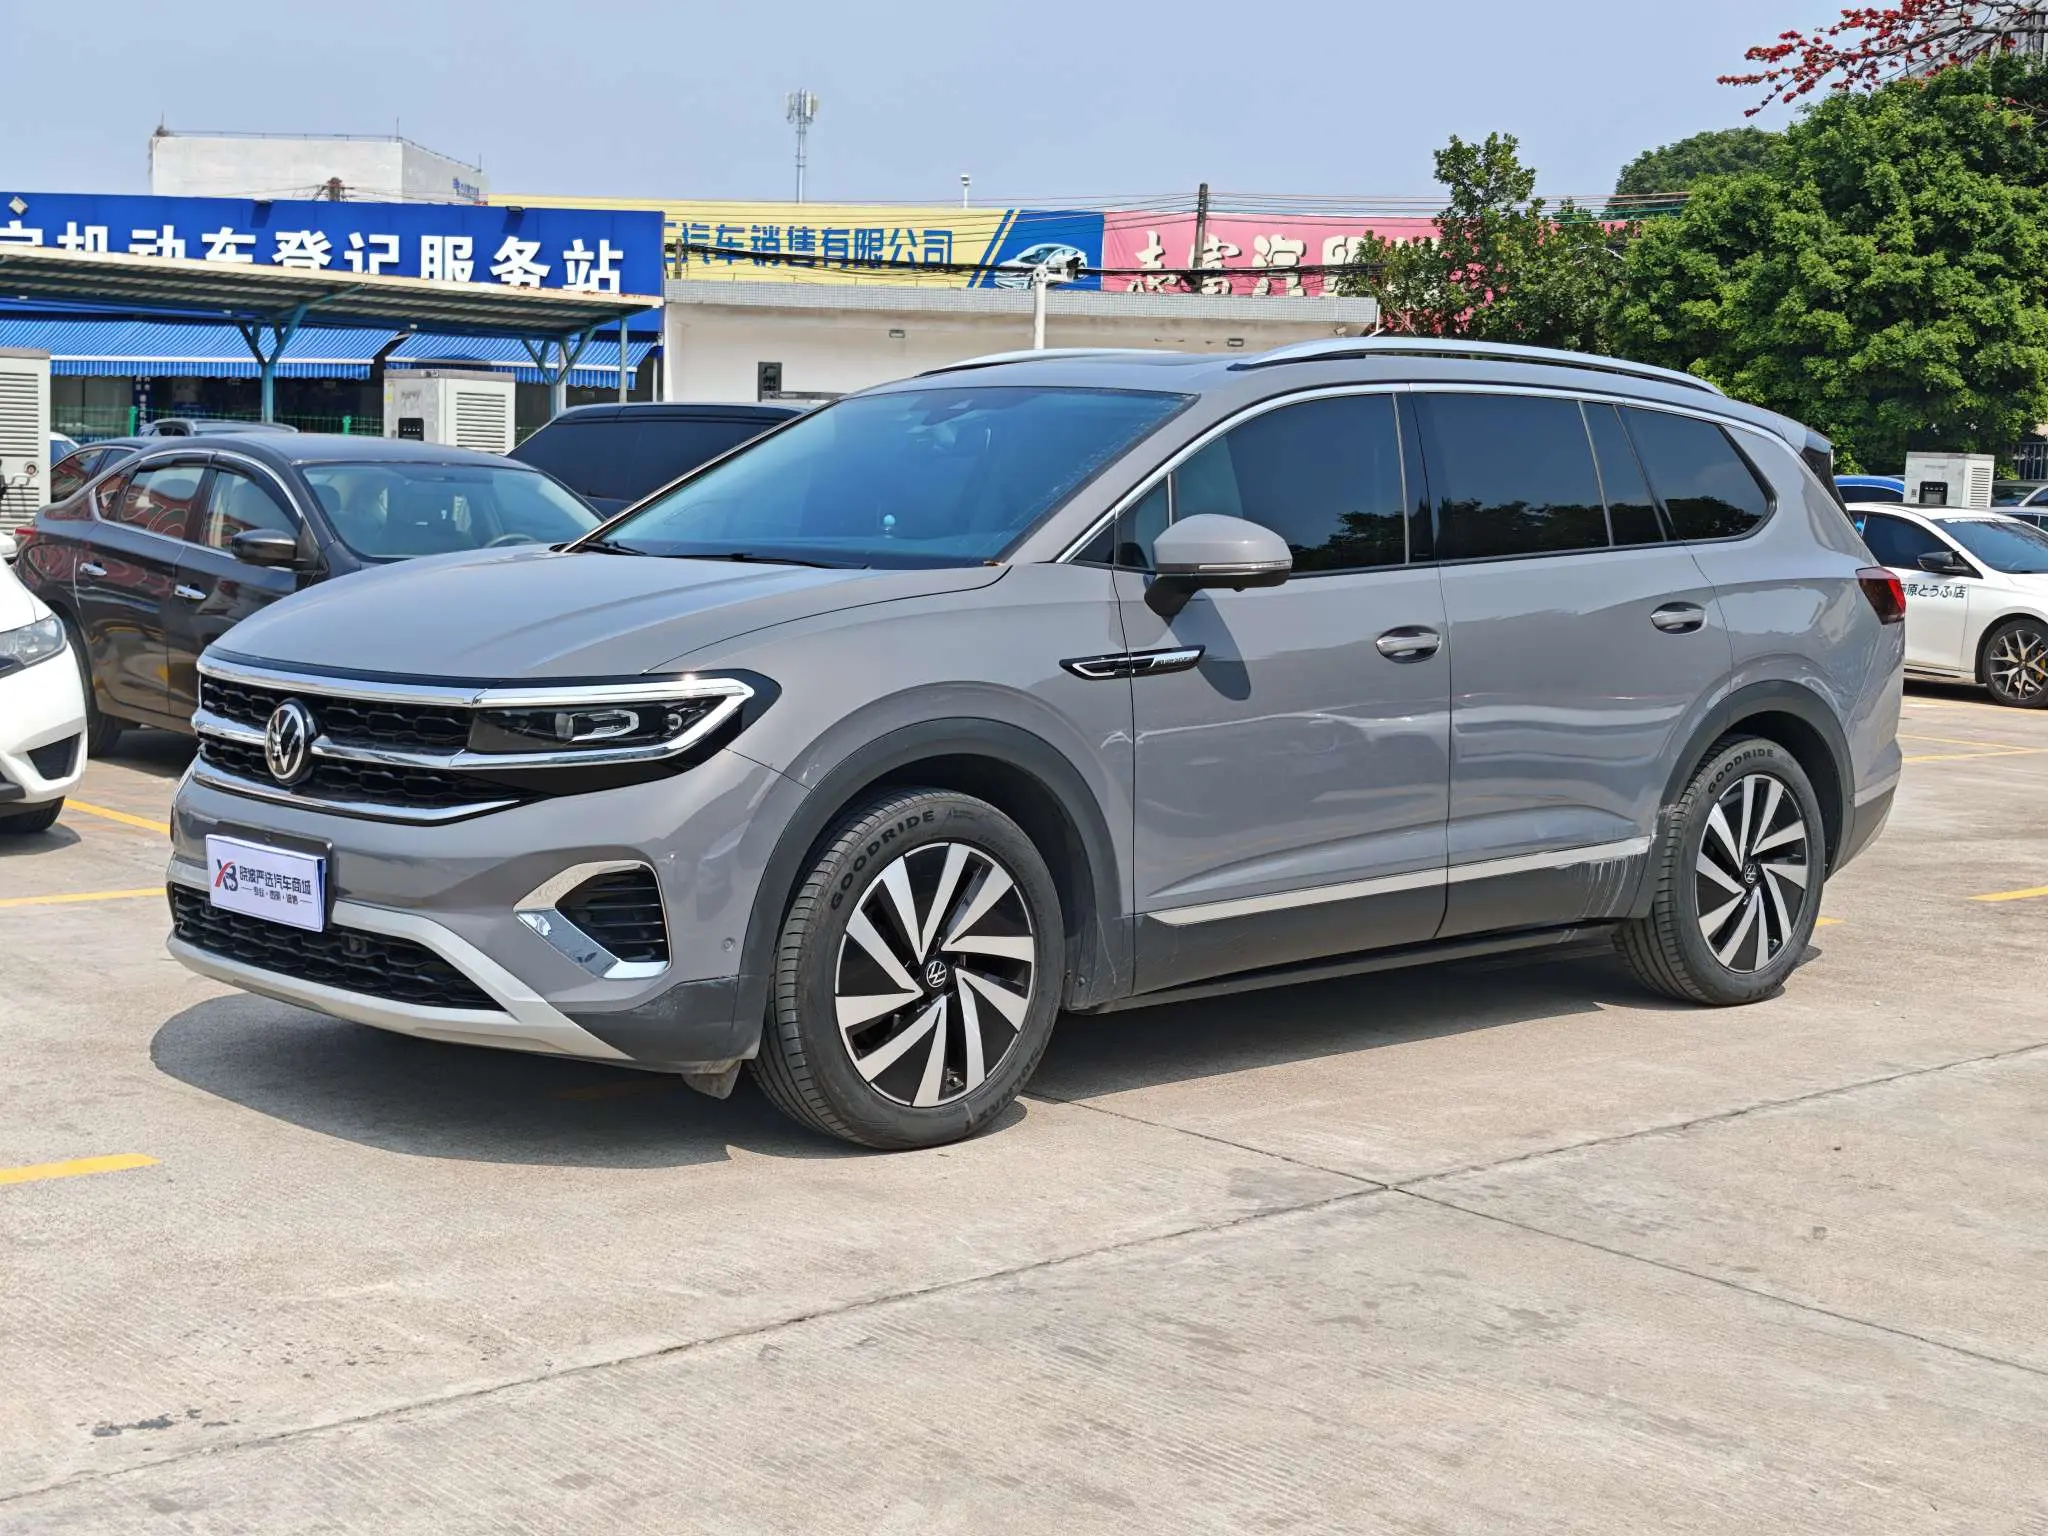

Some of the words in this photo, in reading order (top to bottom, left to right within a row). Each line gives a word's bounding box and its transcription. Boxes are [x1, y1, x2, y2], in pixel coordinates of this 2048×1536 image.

[664, 222, 953, 270] 汽车销售有限公司
[1708, 748, 1774, 793] GOODRIDE
[831, 810, 934, 911] GOODRIDE
